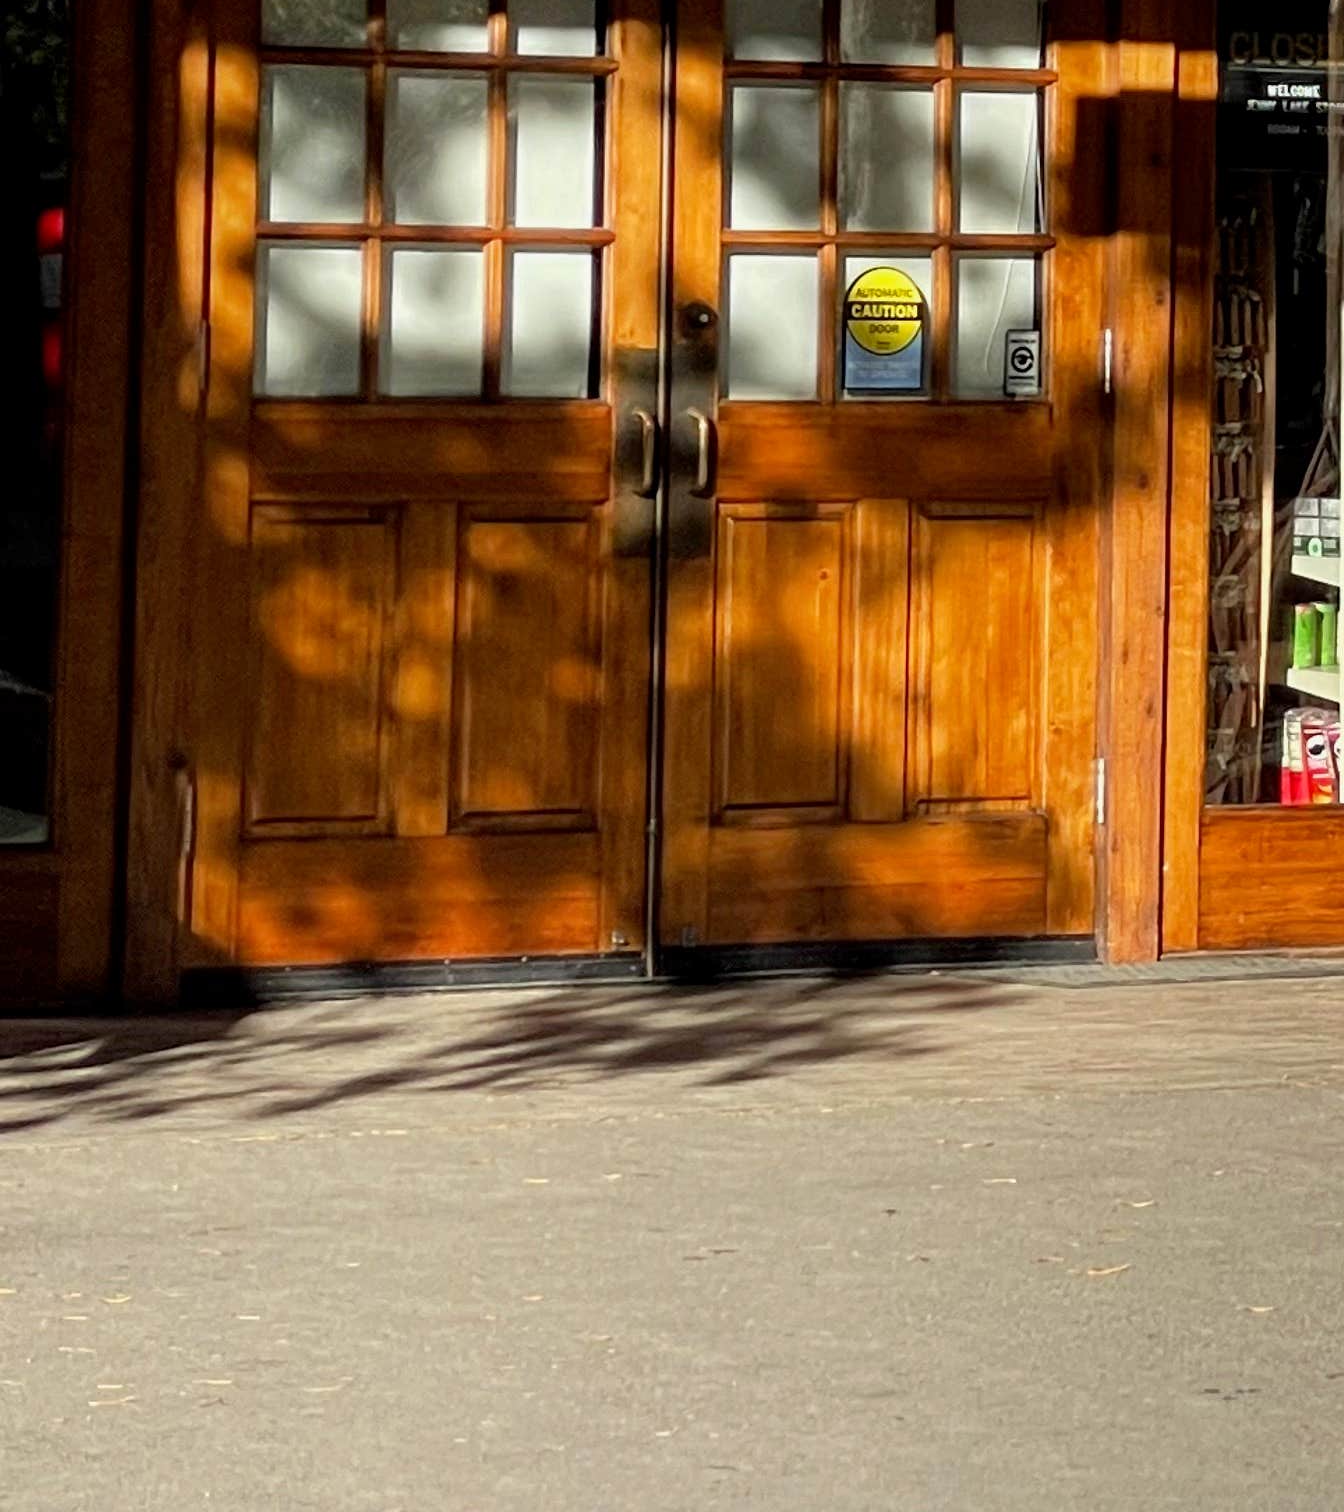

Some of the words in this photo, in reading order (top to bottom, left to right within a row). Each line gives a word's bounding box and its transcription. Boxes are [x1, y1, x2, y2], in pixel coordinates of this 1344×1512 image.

[855, 287, 913, 298] AUTOMATIC
[851, 304, 918, 318] CAUTION
[868, 324, 899, 334] DOOR
